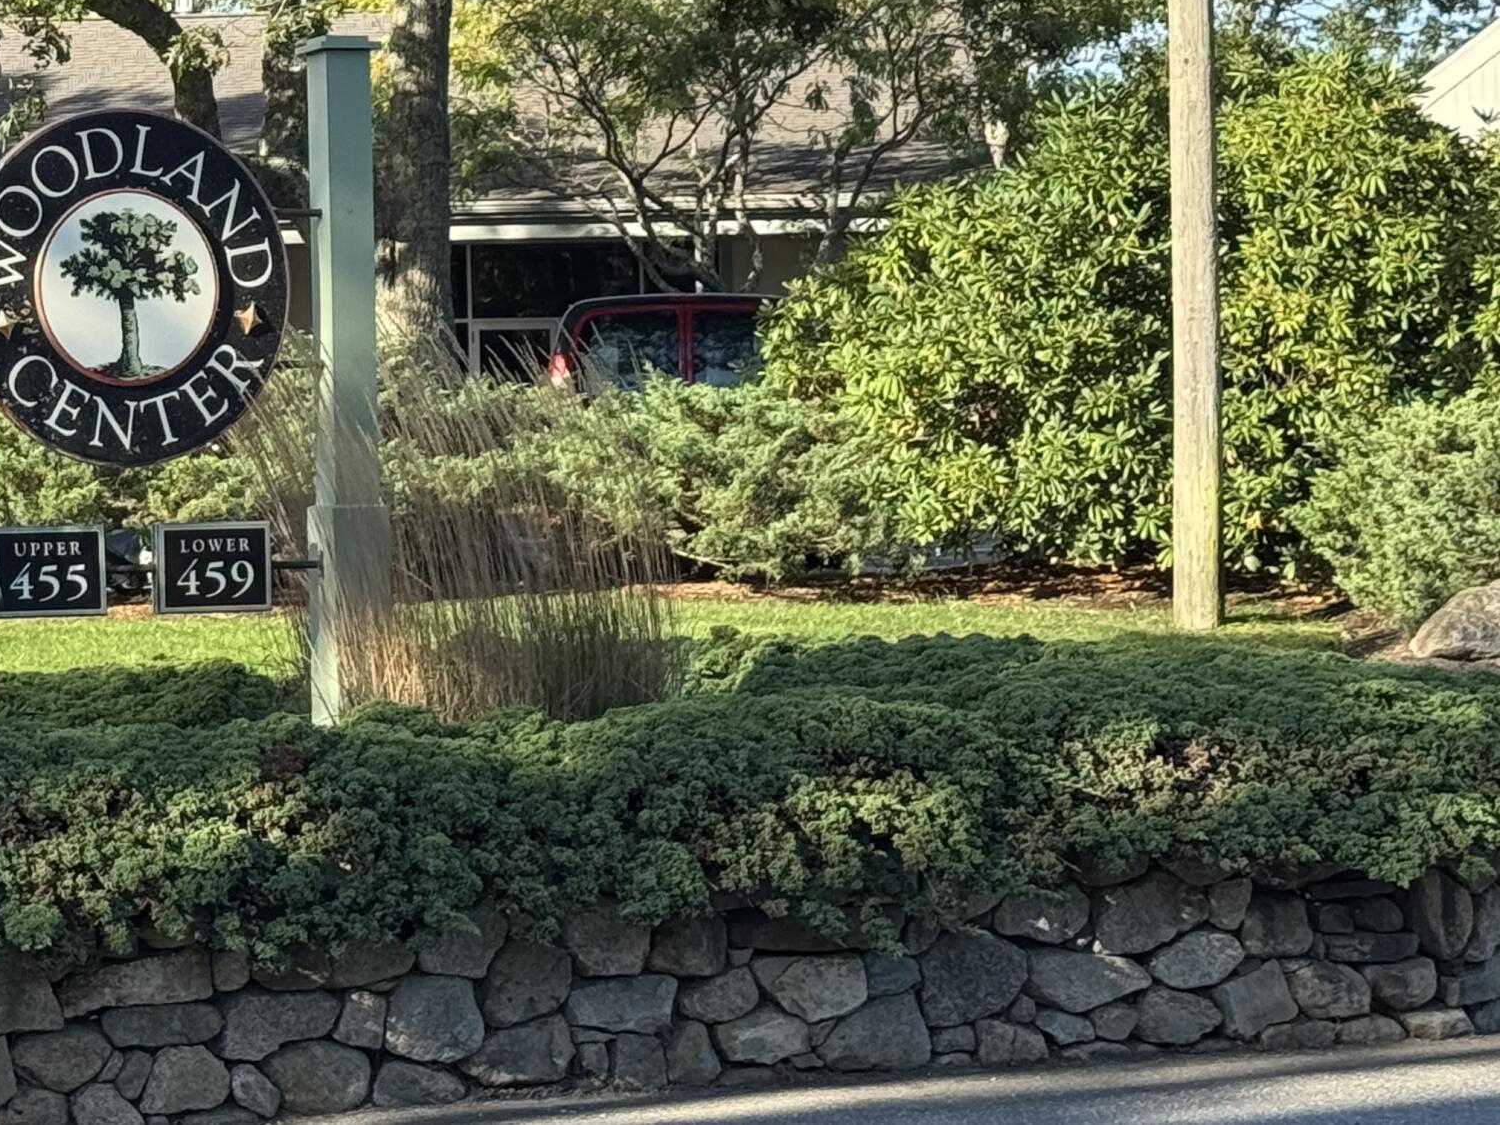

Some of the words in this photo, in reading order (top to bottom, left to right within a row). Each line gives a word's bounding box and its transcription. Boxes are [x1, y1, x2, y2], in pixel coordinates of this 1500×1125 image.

[8, 344, 264, 451] CENTER
[13, 541, 82, 557] UPPER
[180, 537, 250, 554] LOWER
[9, 562, 89, 602] 455
[176, 557, 255, 598] 459
